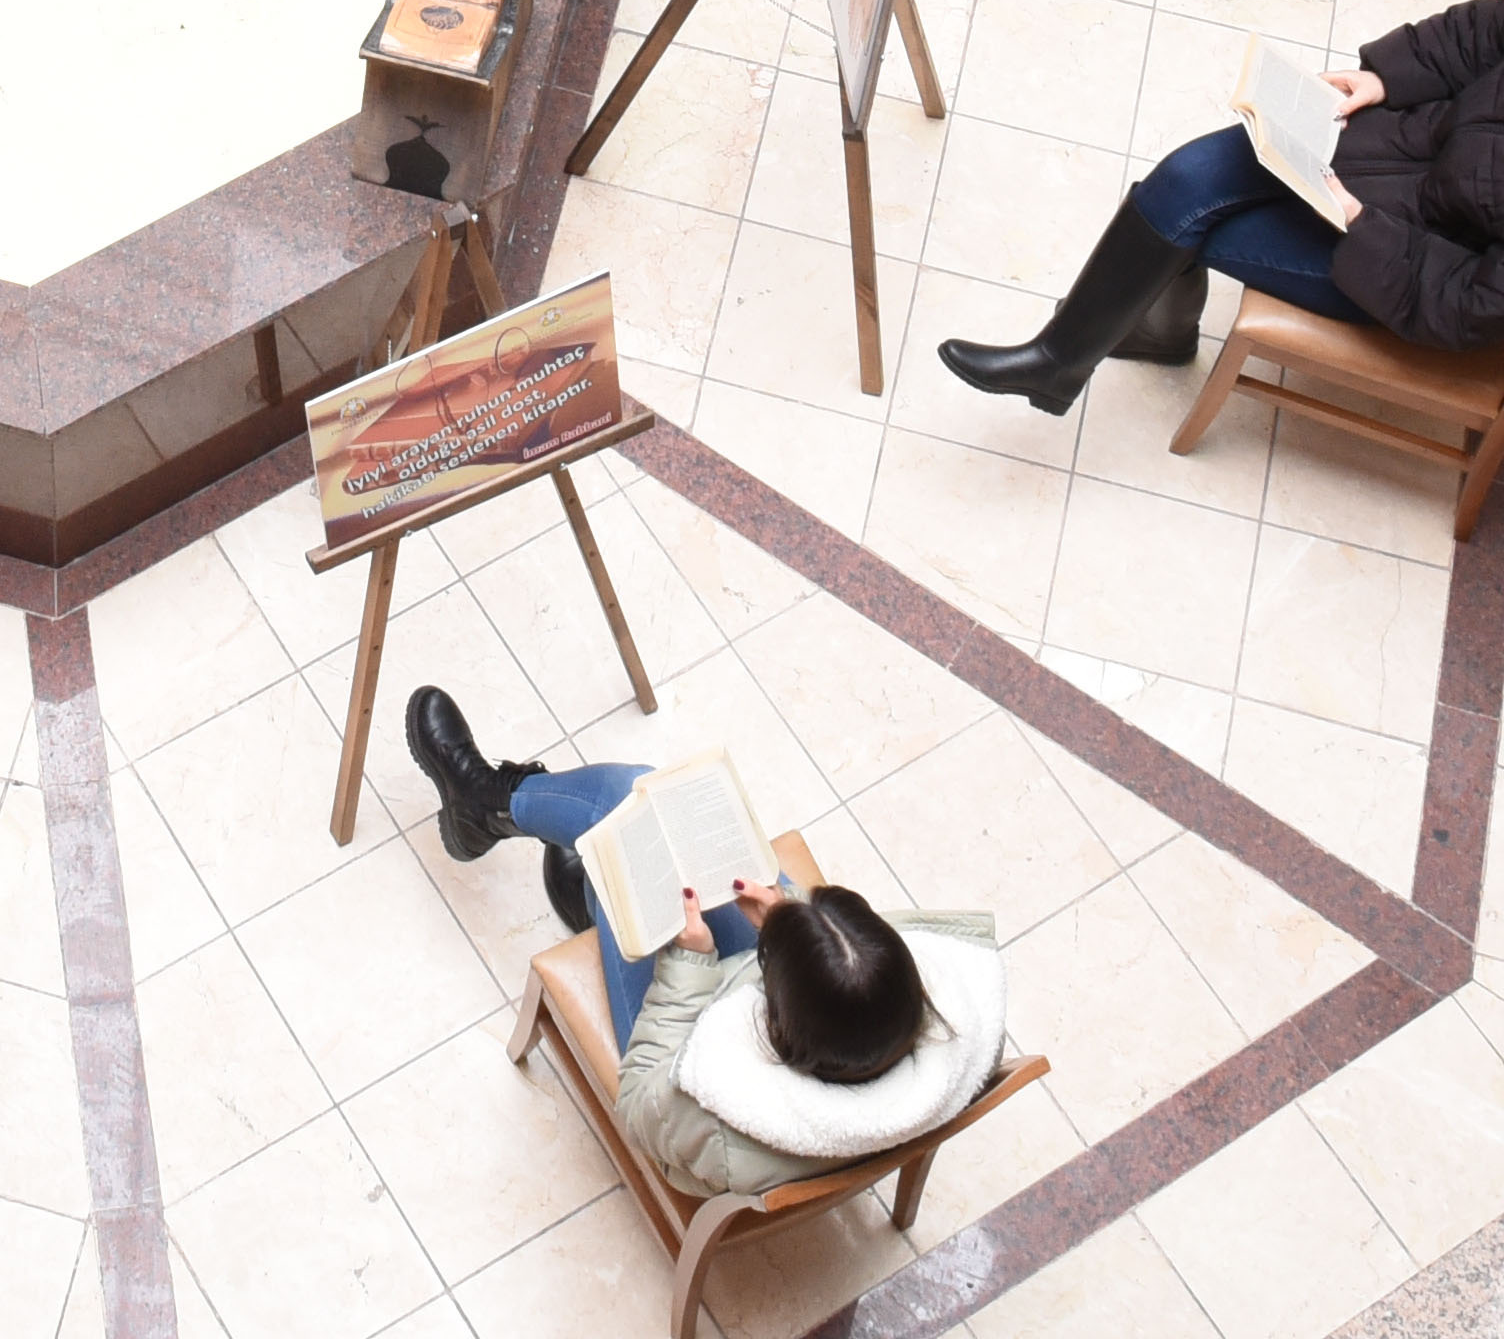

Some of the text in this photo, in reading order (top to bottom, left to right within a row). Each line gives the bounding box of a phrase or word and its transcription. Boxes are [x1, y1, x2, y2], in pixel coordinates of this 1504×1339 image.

[392, 425, 454, 469] arayan
[456, 392, 513, 430] ruhun
[515, 346, 586, 394] muhtaç
[398, 437, 462, 481] olduğu
[501, 391, 547, 420] dost,
[439, 421, 520, 475] seslenen
[523, 377, 594, 424] kitaptır.
[560, 412, 613, 445] Rabbani
